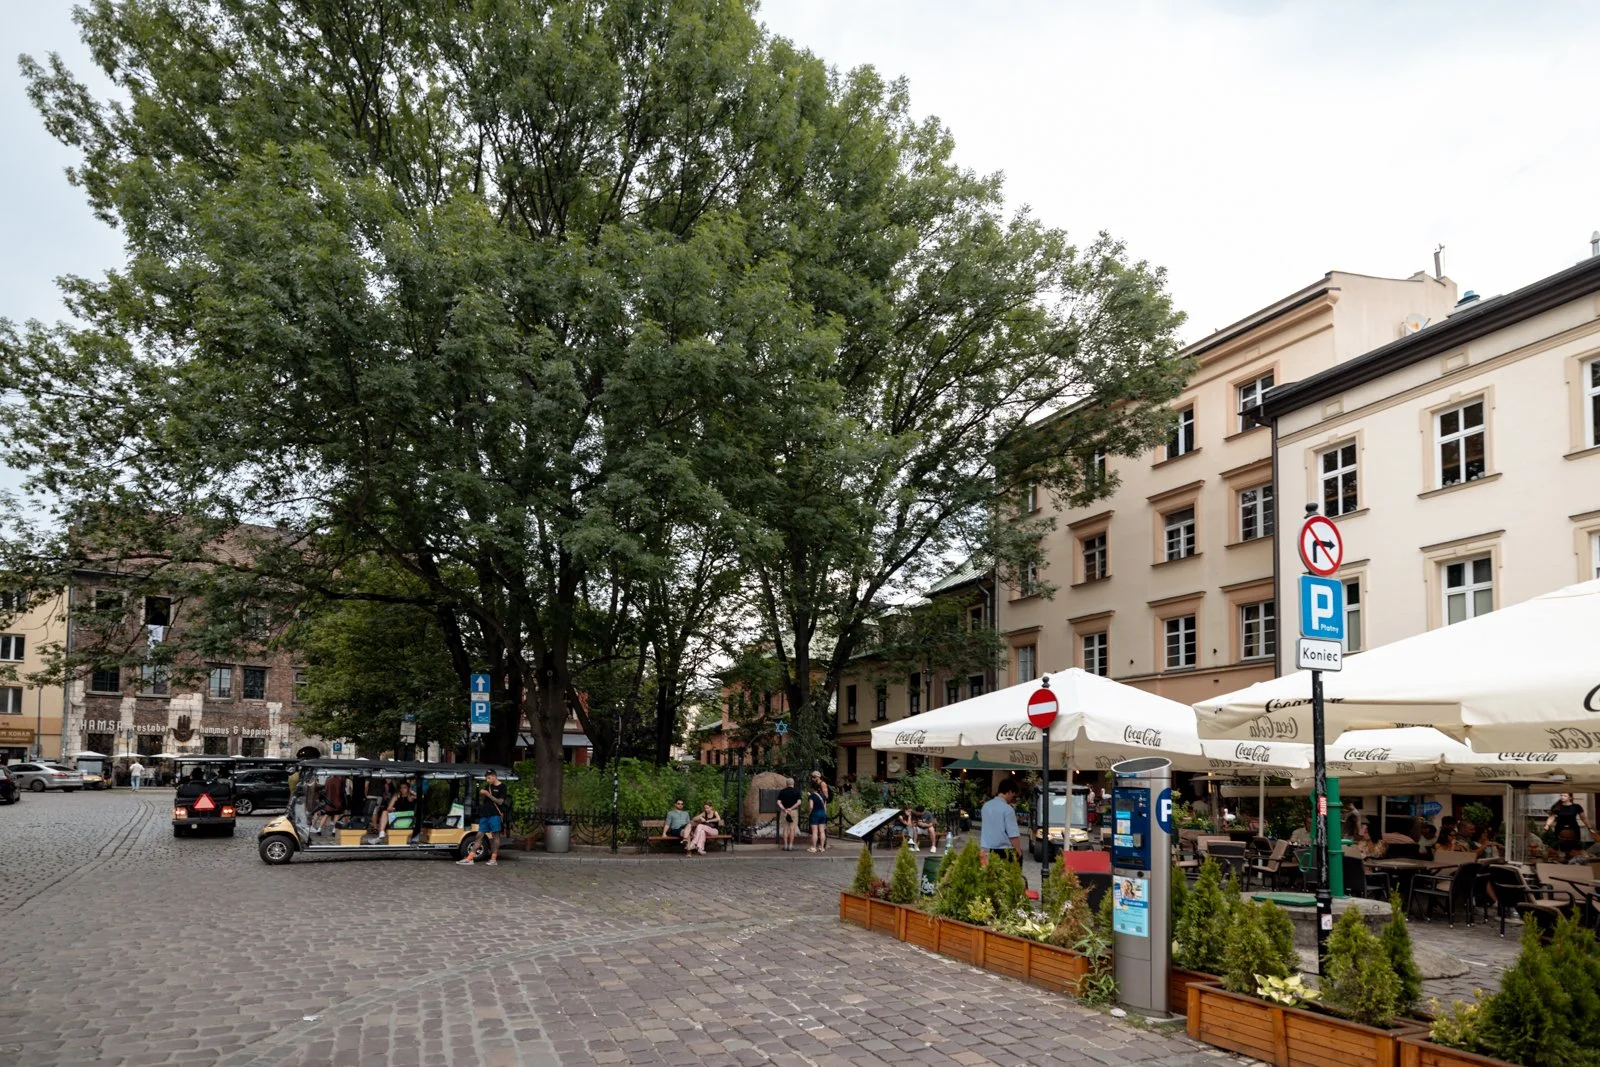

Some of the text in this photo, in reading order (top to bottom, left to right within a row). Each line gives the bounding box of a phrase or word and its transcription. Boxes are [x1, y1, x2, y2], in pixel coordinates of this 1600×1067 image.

[1311, 584, 1333, 630] P
[1302, 647, 1338, 662] Koniec
[475, 702, 486, 716] P
[80, 719, 123, 731] HAMSA
[133, 723, 169, 732] restobar
[200, 725, 230, 734] hummus
[233, 725, 238, 735] &
[1124, 724, 1162, 748] Coca-Cola
[1235, 742, 1272, 763] Coca-Cola
[1343, 747, 1392, 761] Coca-Cola
